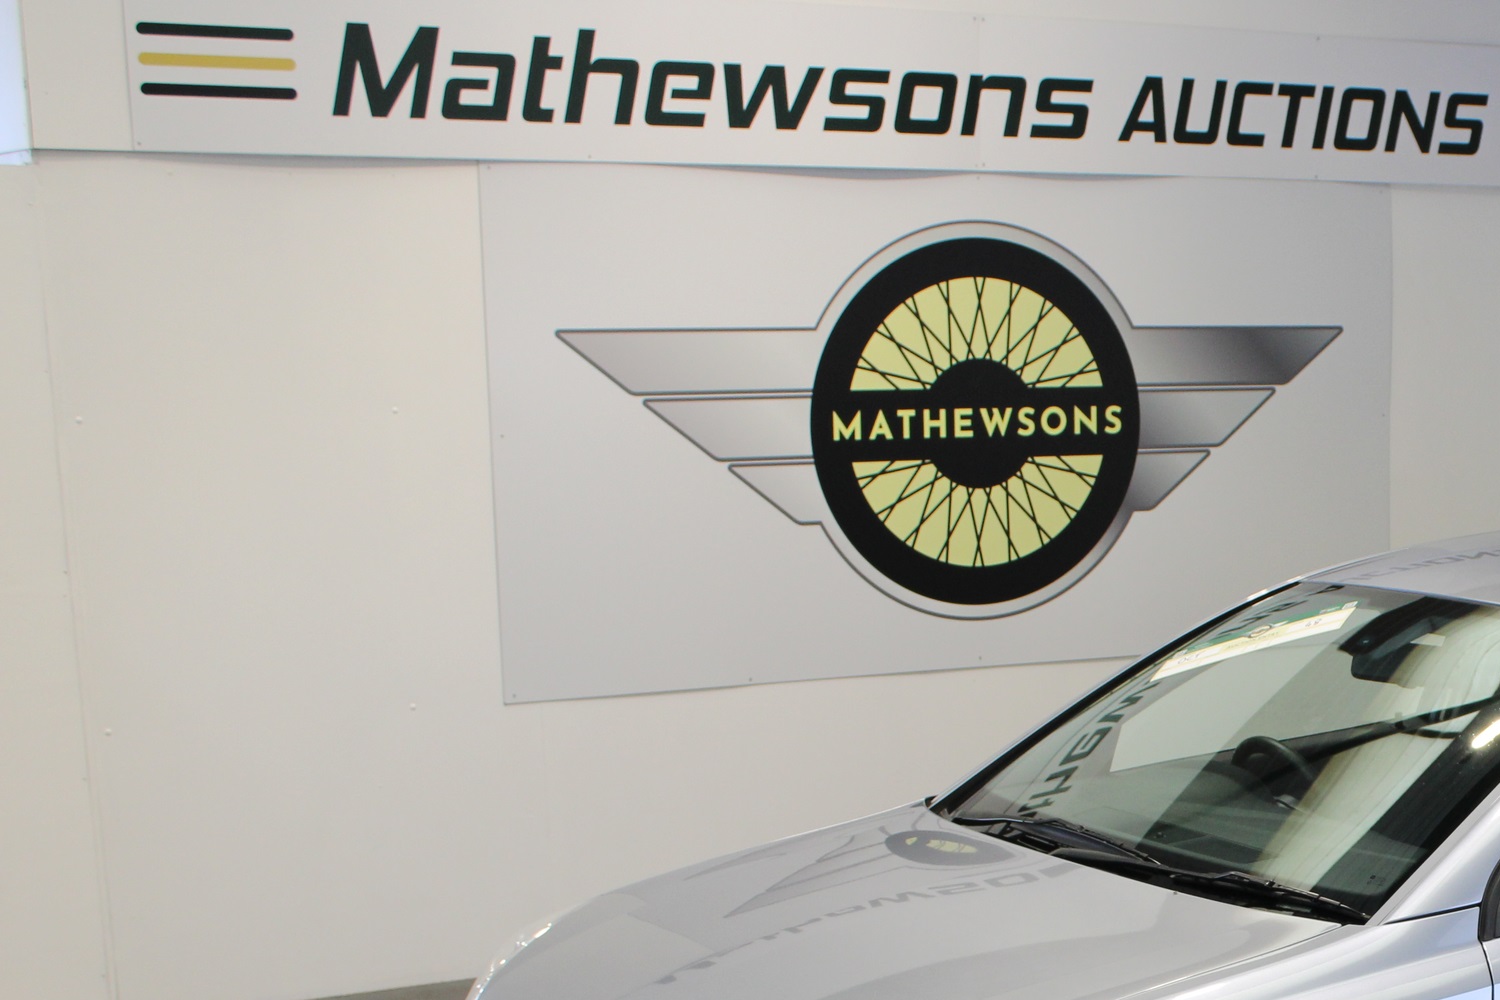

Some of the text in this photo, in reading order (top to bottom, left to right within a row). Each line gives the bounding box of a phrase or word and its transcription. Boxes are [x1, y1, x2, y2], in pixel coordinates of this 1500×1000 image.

[333, 22, 1489, 156] Mathewsons AUCTIONS
[832, 404, 1122, 442] MATHEWSONS
